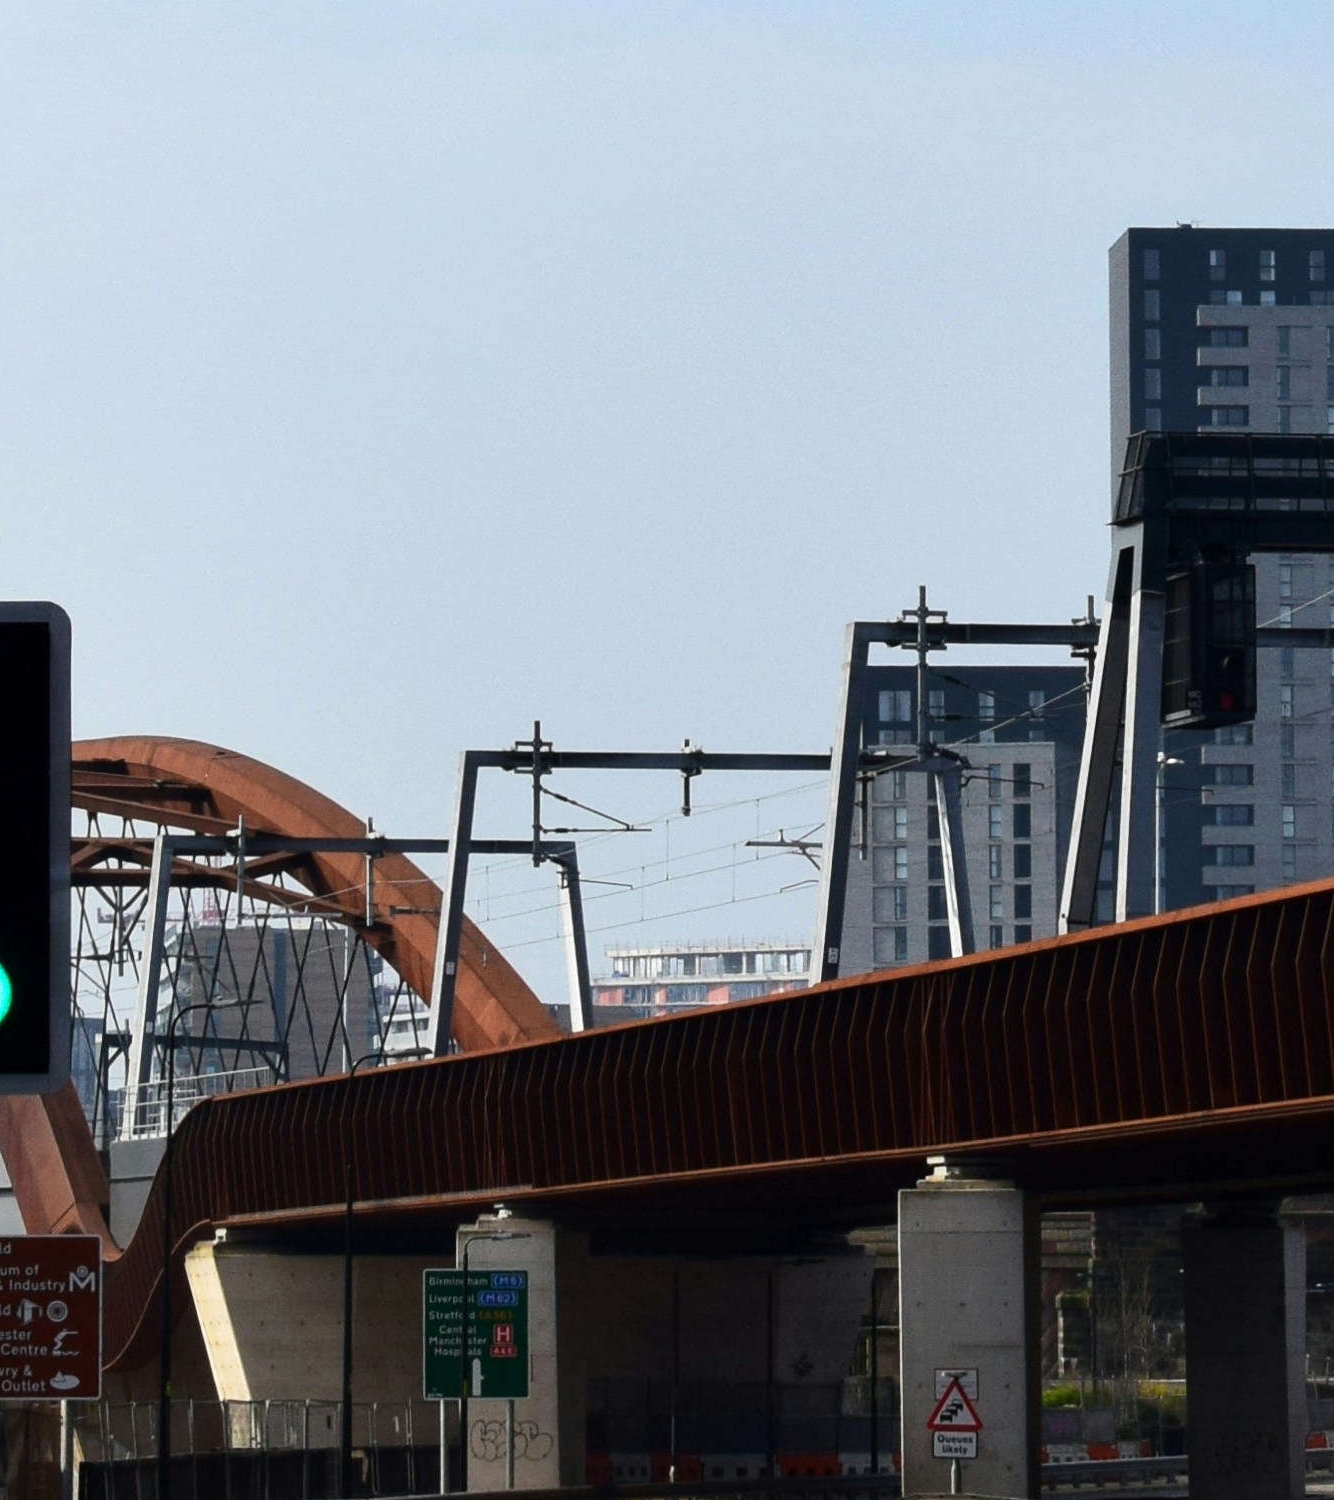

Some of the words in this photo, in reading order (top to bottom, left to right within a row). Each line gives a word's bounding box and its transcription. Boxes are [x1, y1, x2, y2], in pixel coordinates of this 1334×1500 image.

[25, 1264, 40, 1276] of
[8, 1280, 66, 1293] Industry
[428, 1276, 488, 1286] Birminham
[428, 1310, 476, 1320] Stretfod
[439, 1325, 477, 1334] Cental
[497, 1326, 510, 1342] H
[428, 1336, 487, 1345] Manchster
[0, 1344, 47, 1356] Centre
[434, 1347, 482, 1357] Hospials
[23, 1364, 33, 1376] &
[2, 1379, 46, 1392] Outlet
[937, 1434, 974, 1444] Queues
